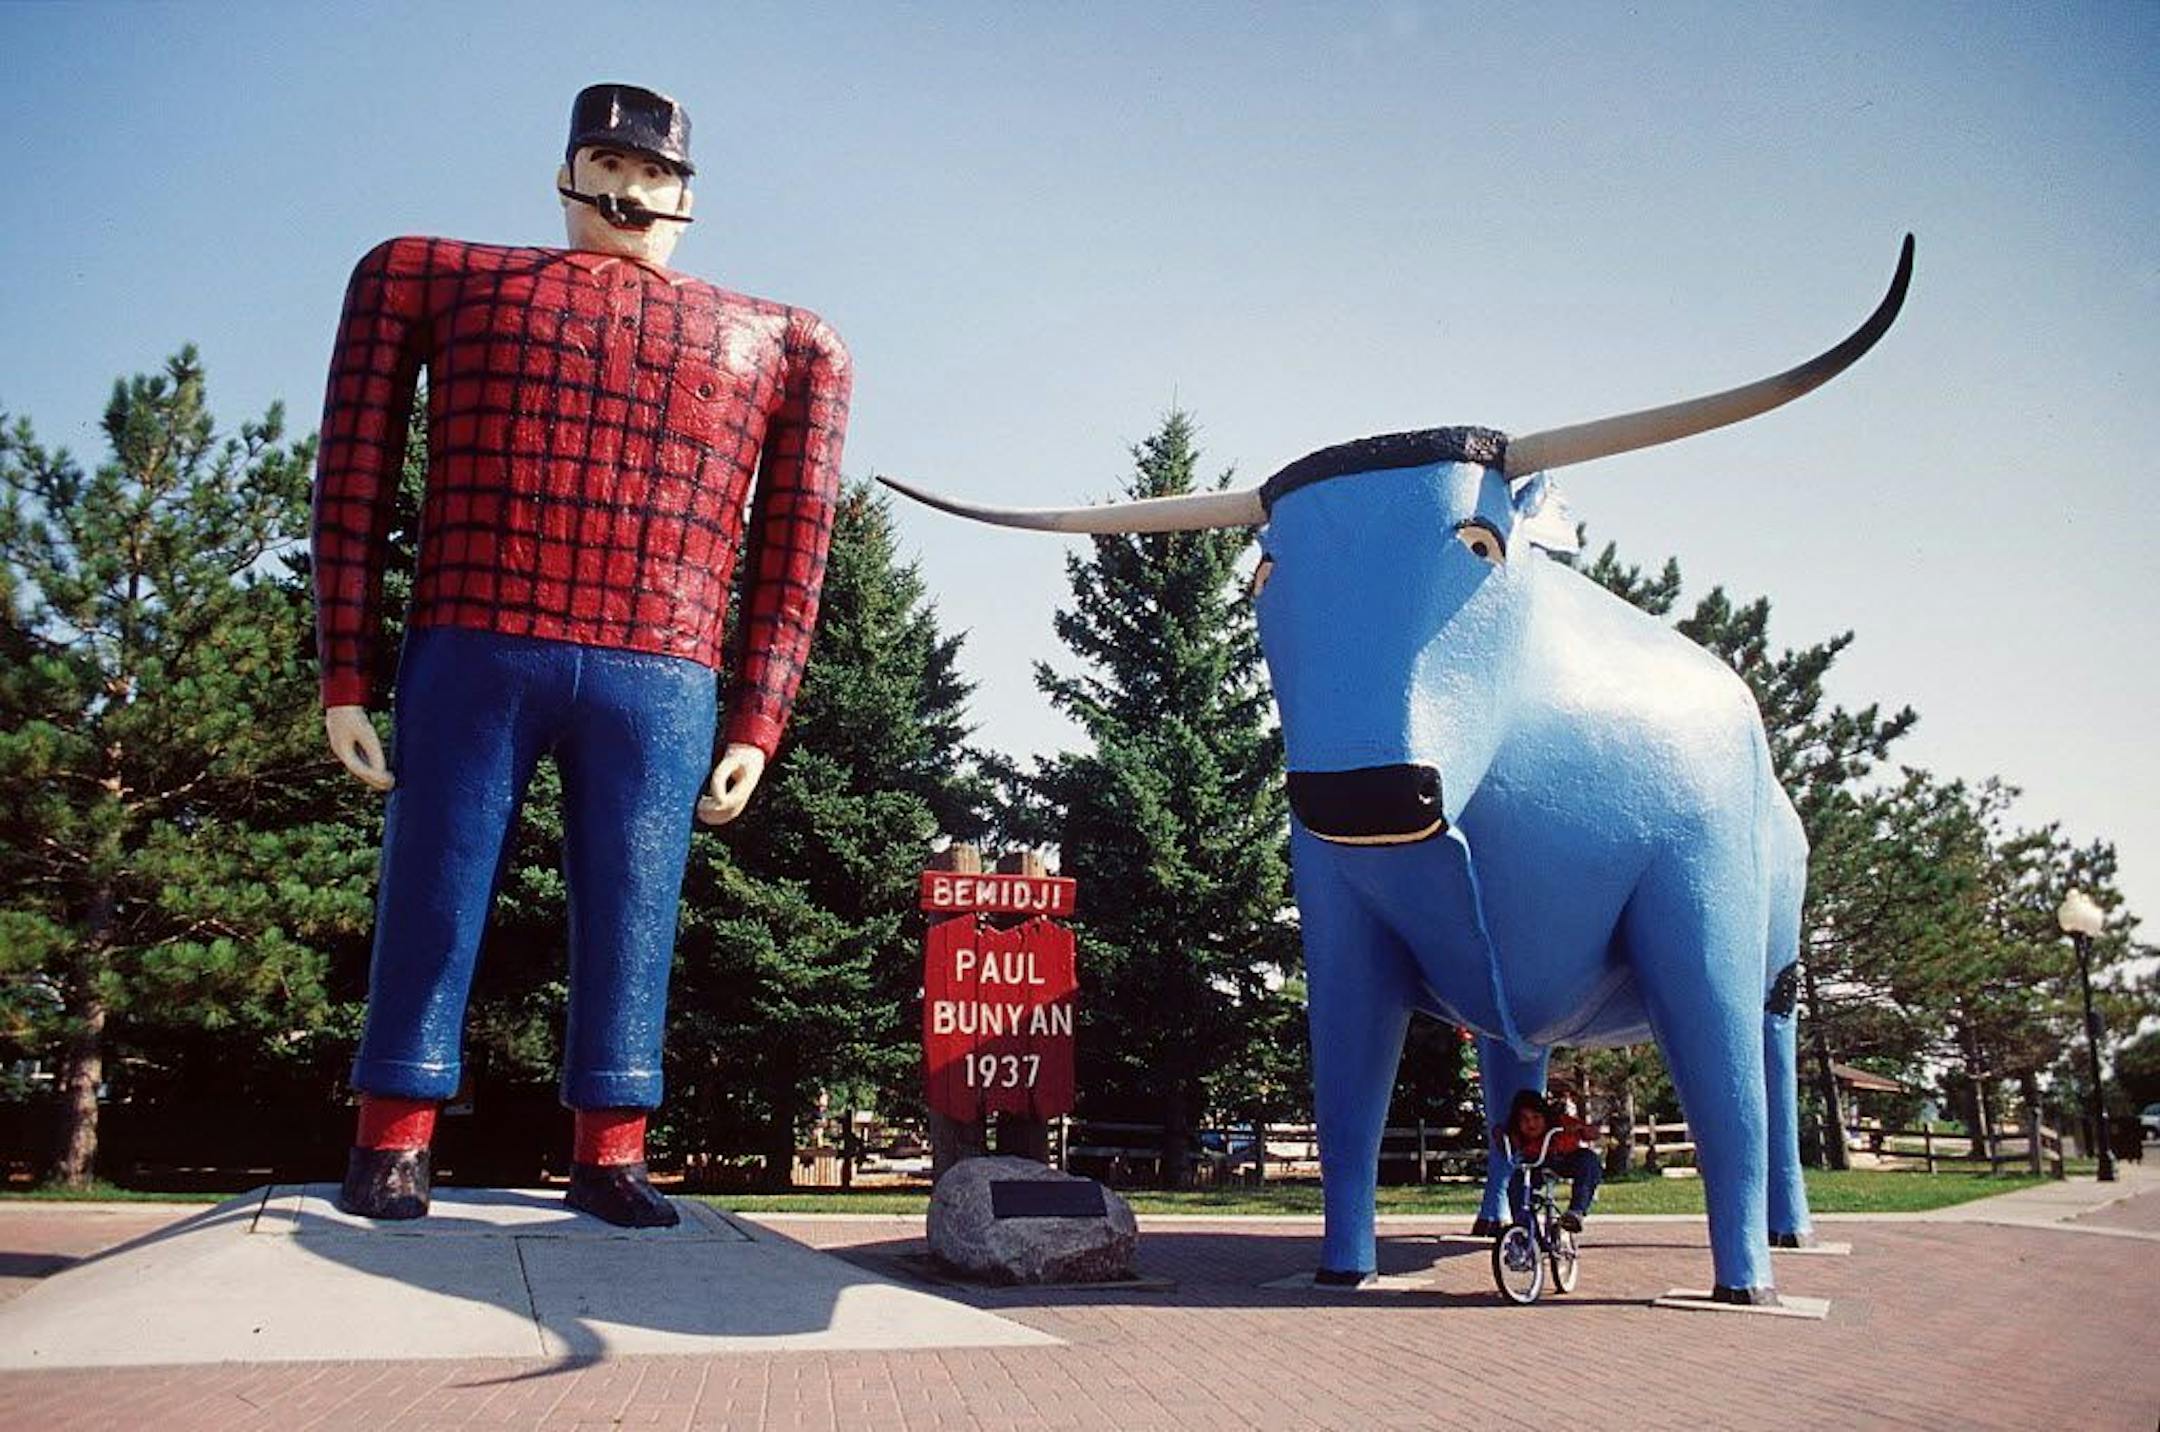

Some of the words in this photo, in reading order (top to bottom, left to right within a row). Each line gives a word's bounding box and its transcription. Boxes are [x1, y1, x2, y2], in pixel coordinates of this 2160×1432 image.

[932, 877, 1062, 909] BEMIDJI
[955, 949, 1046, 985] PAUL
[932, 1000, 1074, 1037] BUNYAN
[965, 1053, 1042, 1089] 1937
